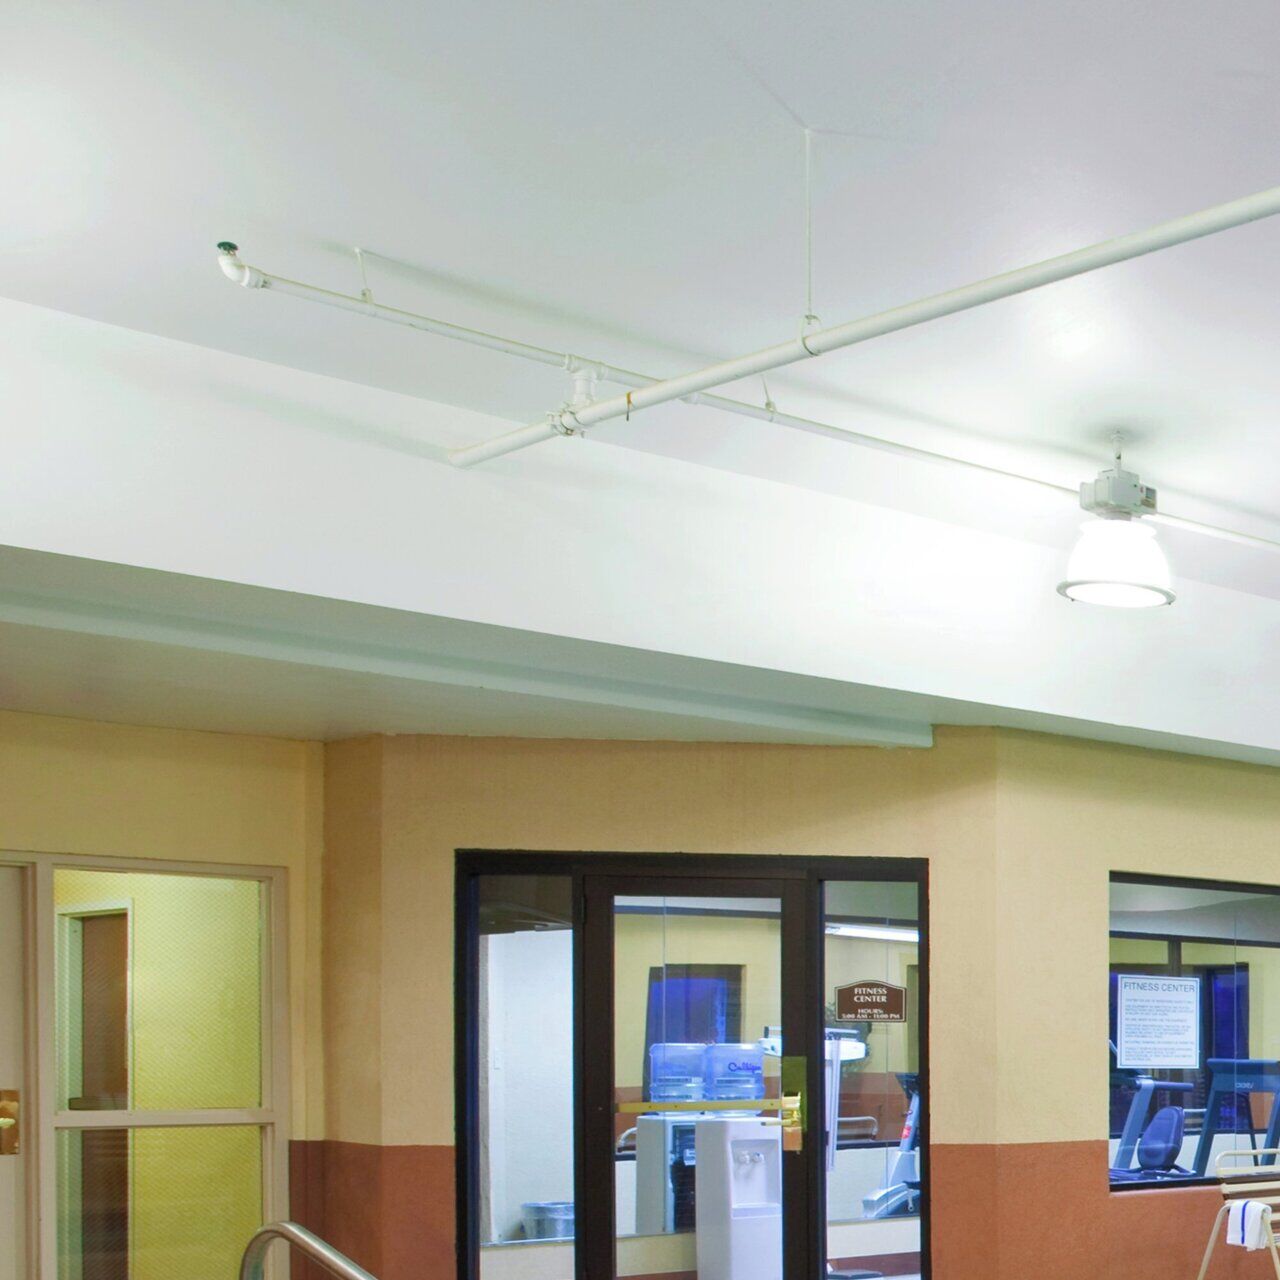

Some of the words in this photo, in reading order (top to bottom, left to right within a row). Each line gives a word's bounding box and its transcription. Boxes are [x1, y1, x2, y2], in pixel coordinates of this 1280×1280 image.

[853, 987, 888, 995] FITNESS
[1123, 981, 1160, 992] FITNESS
[1161, 983, 1195, 993] CENTER
[853, 995, 887, 1003] CENTER
